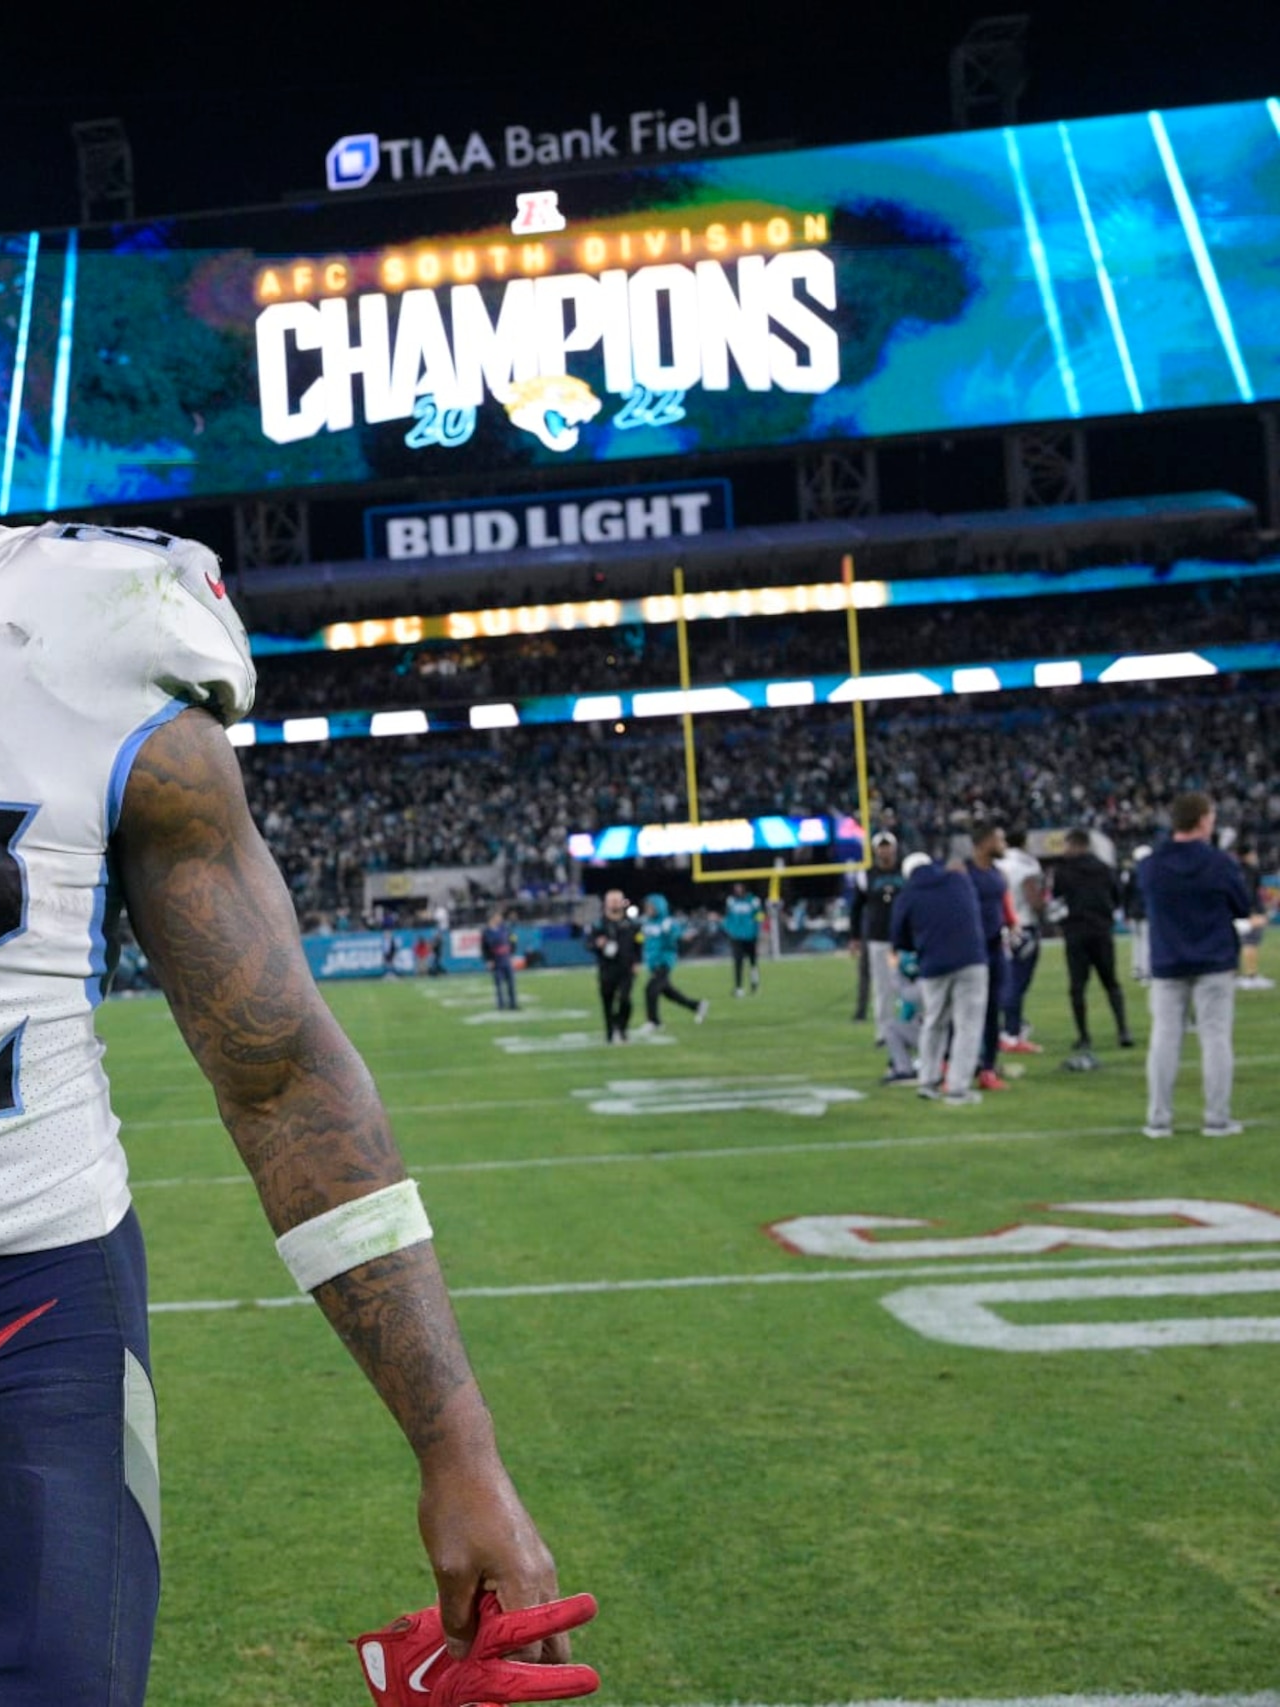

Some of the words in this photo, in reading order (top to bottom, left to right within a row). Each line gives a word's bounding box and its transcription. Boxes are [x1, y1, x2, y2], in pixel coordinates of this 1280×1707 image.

[380, 131, 496, 182] TIAA
[504, 112, 619, 168] Bank
[628, 97, 742, 154] Field
[259, 262, 350, 298] AFC
[381, 242, 549, 288] SOUTH
[581, 213, 828, 266] DIVISION
[255, 249, 841, 444] CHAMPIONS
[405, 394, 477, 449] 20
[386, 510, 519, 560] BUD
[526, 493, 712, 548] LIGHT
